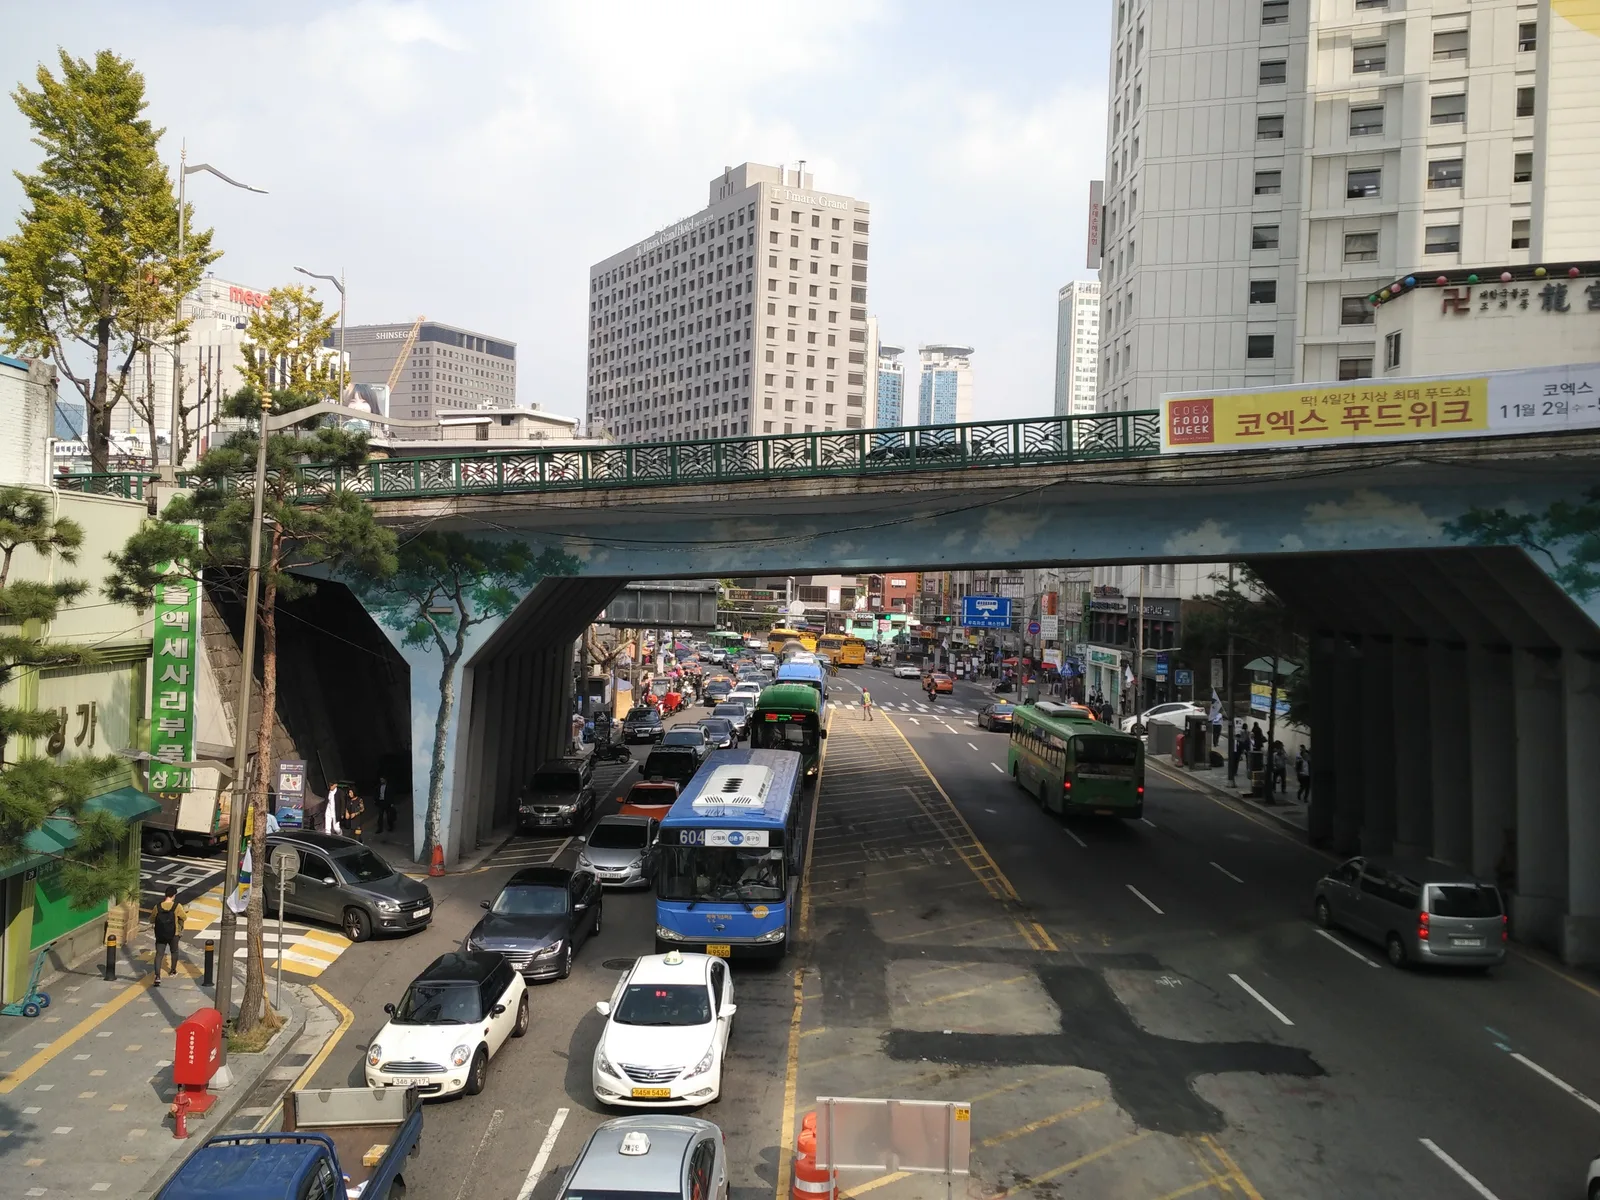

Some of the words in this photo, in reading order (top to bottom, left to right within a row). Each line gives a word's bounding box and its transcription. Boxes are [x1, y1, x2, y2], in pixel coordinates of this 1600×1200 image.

[784, 189, 817, 205] Tmark
[818, 195, 848, 210] Grand
[677, 218, 694, 237] Hotel
[1301, 395, 1317, 407] 딱!
[1321, 392, 1356, 405] 4일간
[1361, 391, 1388, 402] 지상
[1393, 388, 1420, 401] 최대
[1425, 386, 1472, 399] 푸드쇼!
[1543, 382, 1594, 397] 코엑스
[1173, 405, 1209, 416] COEX
[1500, 403, 1535, 418] 11월
[1542, 401, 1568, 416] 2일
[1173, 415, 1209, 426] FOOD
[1235, 409, 1329, 436] 코엑스
[1340, 401, 1473, 431] 푸드위크
[1173, 425, 1209, 435] WEEK
[1151, 605, 1163, 615] PLACE
[152, 770, 189, 789] 상가
[680, 829, 705, 844] 604
